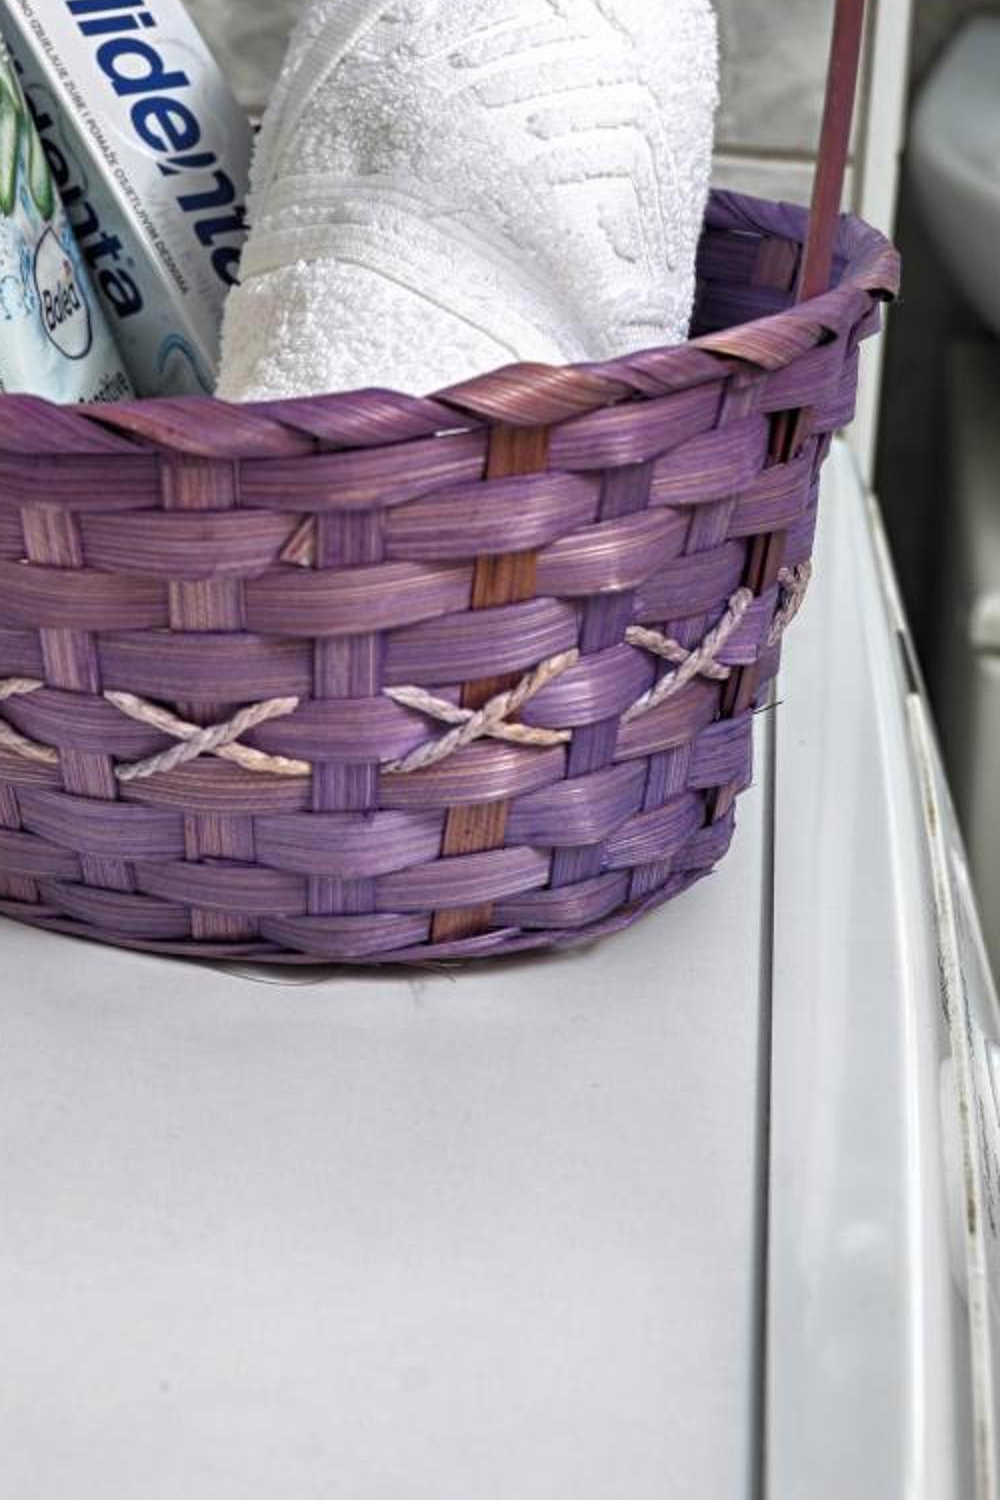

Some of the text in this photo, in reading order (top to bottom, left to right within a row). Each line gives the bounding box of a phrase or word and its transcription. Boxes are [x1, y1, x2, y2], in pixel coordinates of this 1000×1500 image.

[63, 79, 88, 111] ZUBE
[155, 240, 189, 296] DESNIMA
[42, 280, 81, 332] Balea
